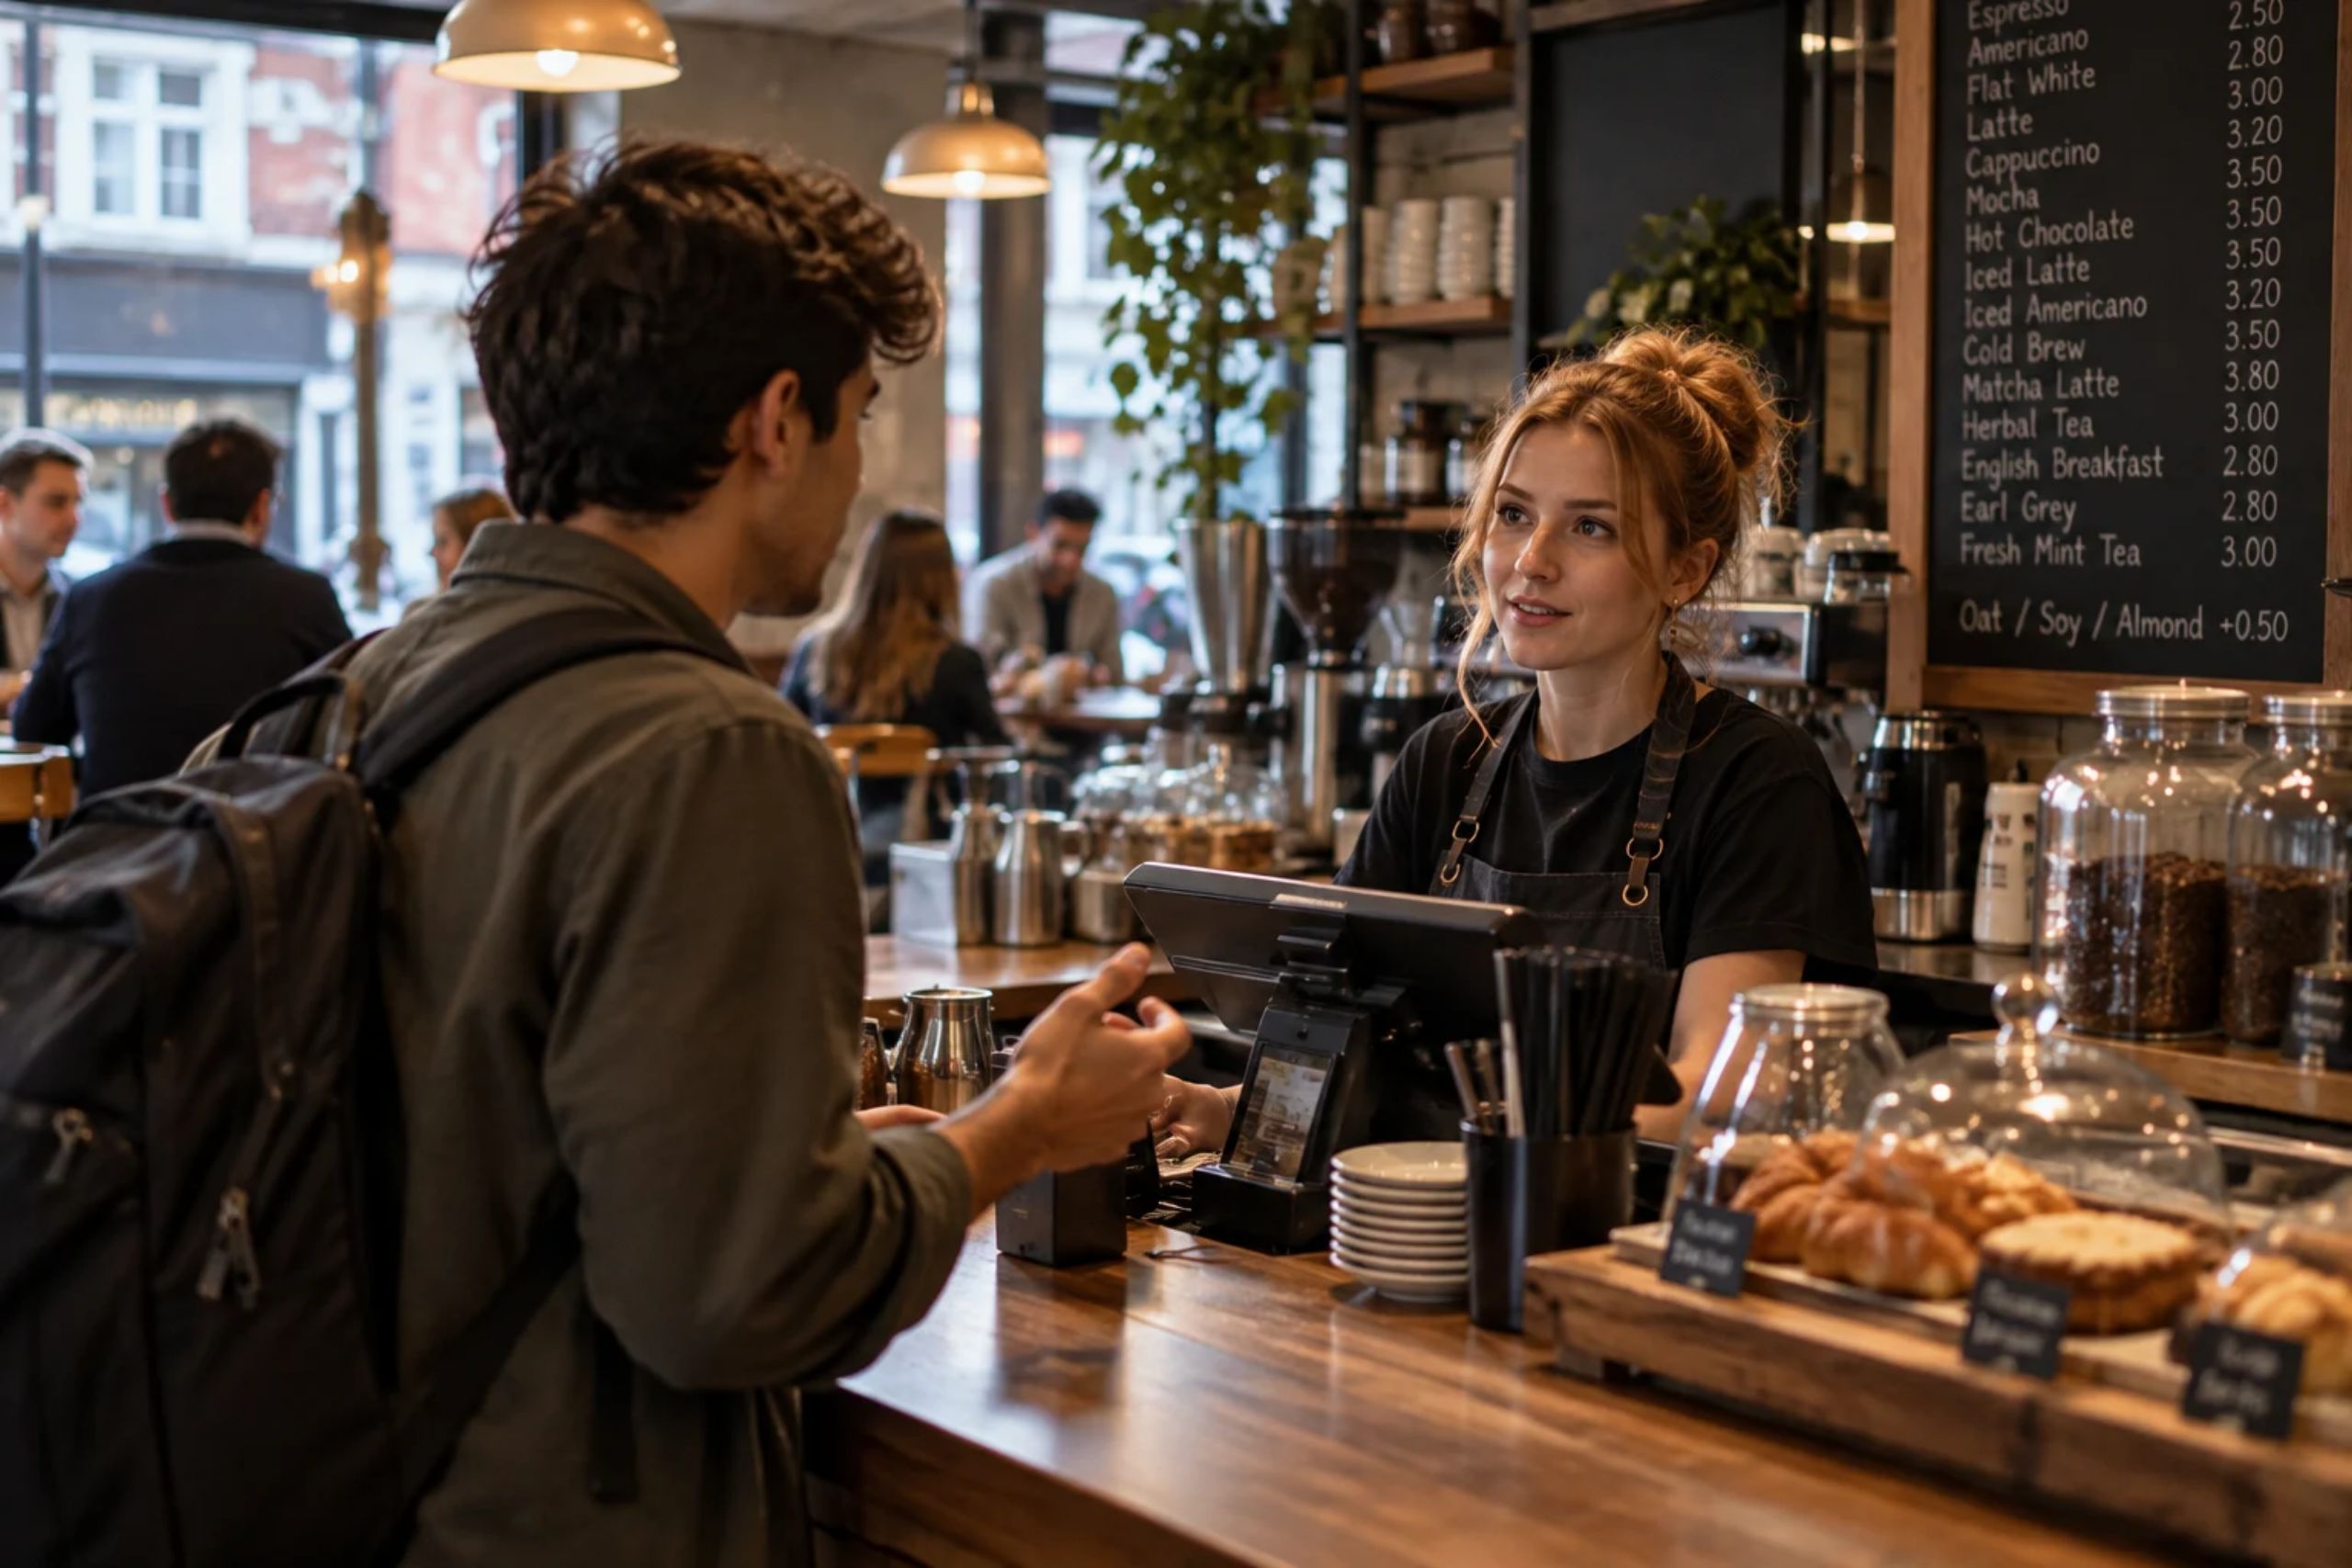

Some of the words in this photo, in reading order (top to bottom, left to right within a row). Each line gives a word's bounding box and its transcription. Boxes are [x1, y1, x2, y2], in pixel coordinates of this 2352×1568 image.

[1968, 0, 2069, 37] Espresso
[2228, 0, 2284, 30] 2.50
[1967, 28, 2088, 67] Americano
[2228, 34, 2284, 71] 2.80
[1967, 73, 2013, 105] Flat
[2028, 61, 2096, 96] White
[2228, 76, 2283, 110] 3.00
[1966, 109, 2033, 141] Latte
[2226, 114, 2283, 150] 3.20
[1965, 139, 2100, 184] Cappuccino
[2226, 154, 2283, 189] 3.50
[1966, 184, 2040, 216] Mocha
[2226, 195, 2282, 230] 3.50
[1965, 224, 2004, 253] Hot
[2018, 209, 2134, 249] Chocolate
[2225, 236, 2281, 270] 3.50
[1965, 257, 2012, 291] Iced
[2027, 253, 2090, 286] Latte
[1964, 296, 2012, 328] Iced
[2026, 293, 2148, 323] Americano
[2225, 277, 2281, 310] 3.20
[1962, 333, 2012, 366] Cold
[2028, 331, 2086, 363] Brew
[2224, 319, 2280, 352] 3.50
[1962, 370, 2042, 402] Matcha
[2056, 367, 2120, 399] Latte
[2224, 359, 2279, 392] 3.80
[1962, 408, 2037, 441] Herbal
[2052, 407, 2095, 438] Tea
[2223, 400, 2279, 434] 3.00
[1962, 447, 2040, 491] English
[2052, 444, 2165, 481] Breakfast
[2222, 444, 2278, 477] 2.80
[1961, 491, 2007, 522] Earl
[2021, 491, 2077, 534] Grey
[2222, 490, 2278, 523] 2.80
[1961, 532, 2021, 566] Fresh
[2034, 534, 2086, 567] Mint
[2099, 533, 2142, 567] Tea
[2221, 536, 2278, 568] 3.00
[1959, 599, 2002, 634] Oat
[2015, 598, 2031, 637] /
[2040, 600, 2082, 648] Soy
[2092, 601, 2108, 639] /
[2116, 604, 2203, 640] Almond
[2220, 609, 2289, 643] +0.50
